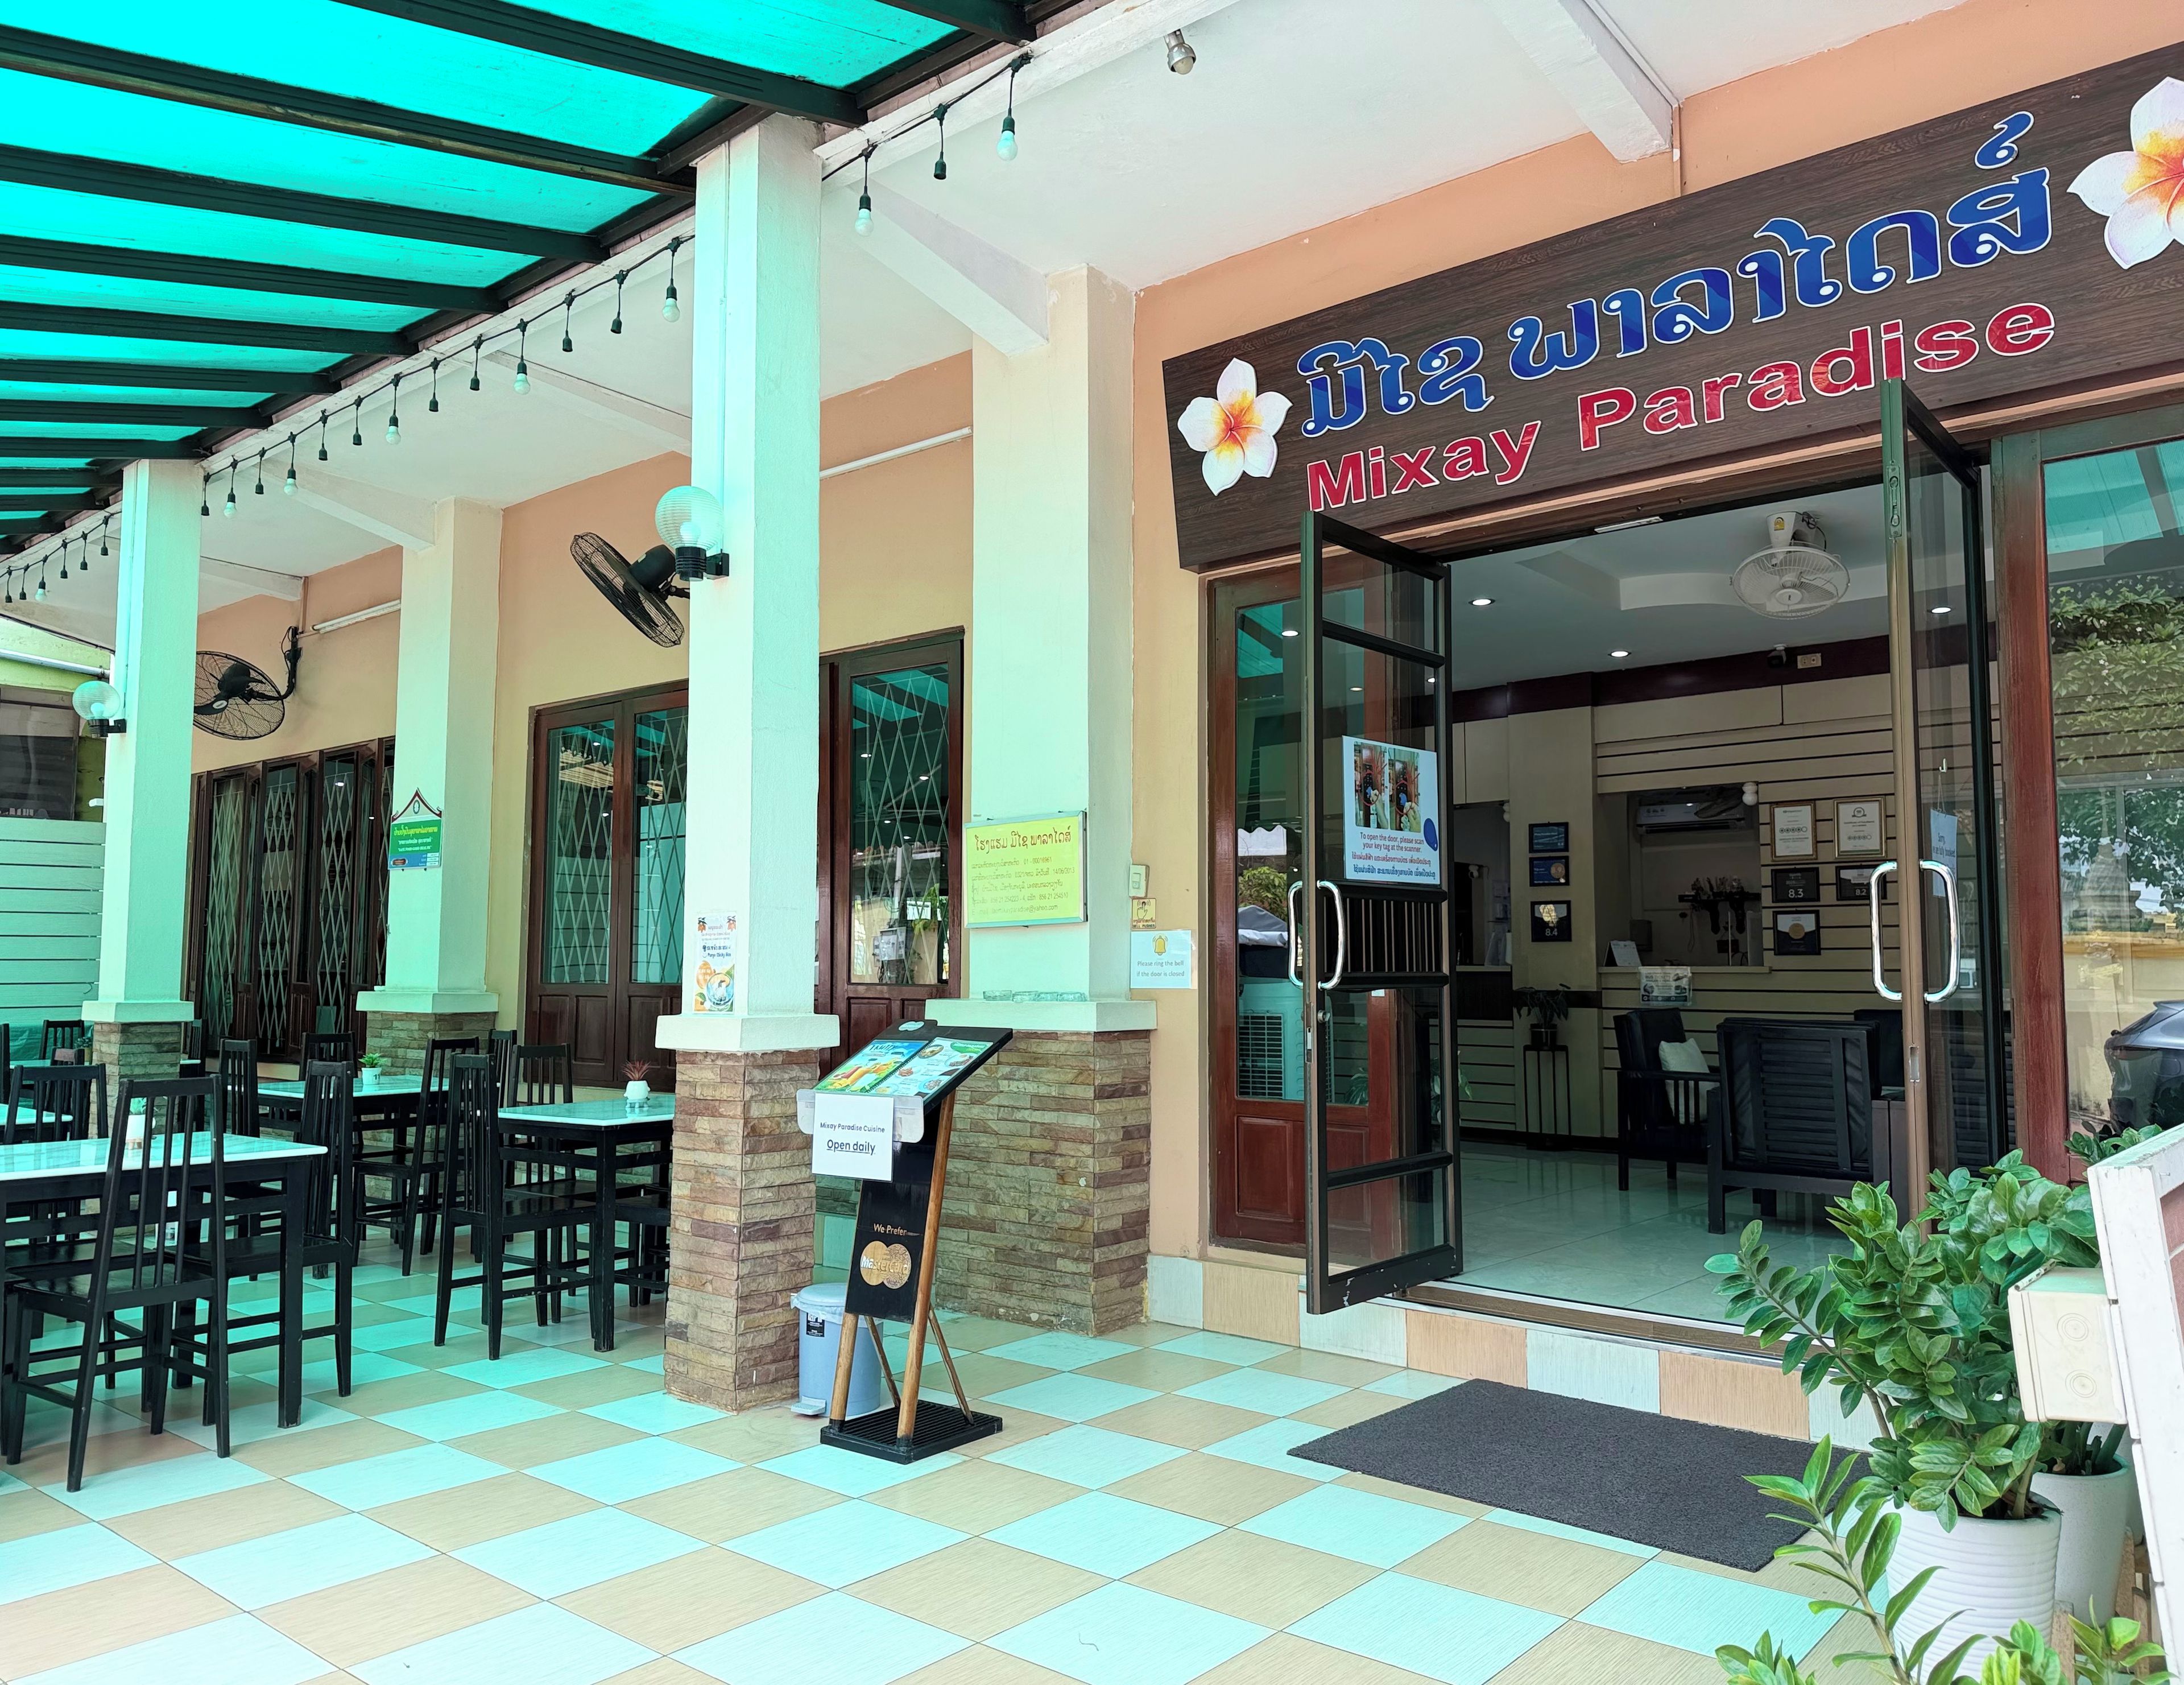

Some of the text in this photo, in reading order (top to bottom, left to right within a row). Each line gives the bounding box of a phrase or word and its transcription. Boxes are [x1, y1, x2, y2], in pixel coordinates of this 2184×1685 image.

[1307, 302, 2055, 513] Mixay Paradise
[1400, 836, 1414, 844] please
[1788, 888, 1804, 898] 8.3
[1545, 928, 1558, 936] 8.4
[820, 1121, 885, 1133] Mixay Paradise Cuisine
[827, 1139, 876, 1156] Open daily
[874, 1223, 907, 1236] We Prefer
